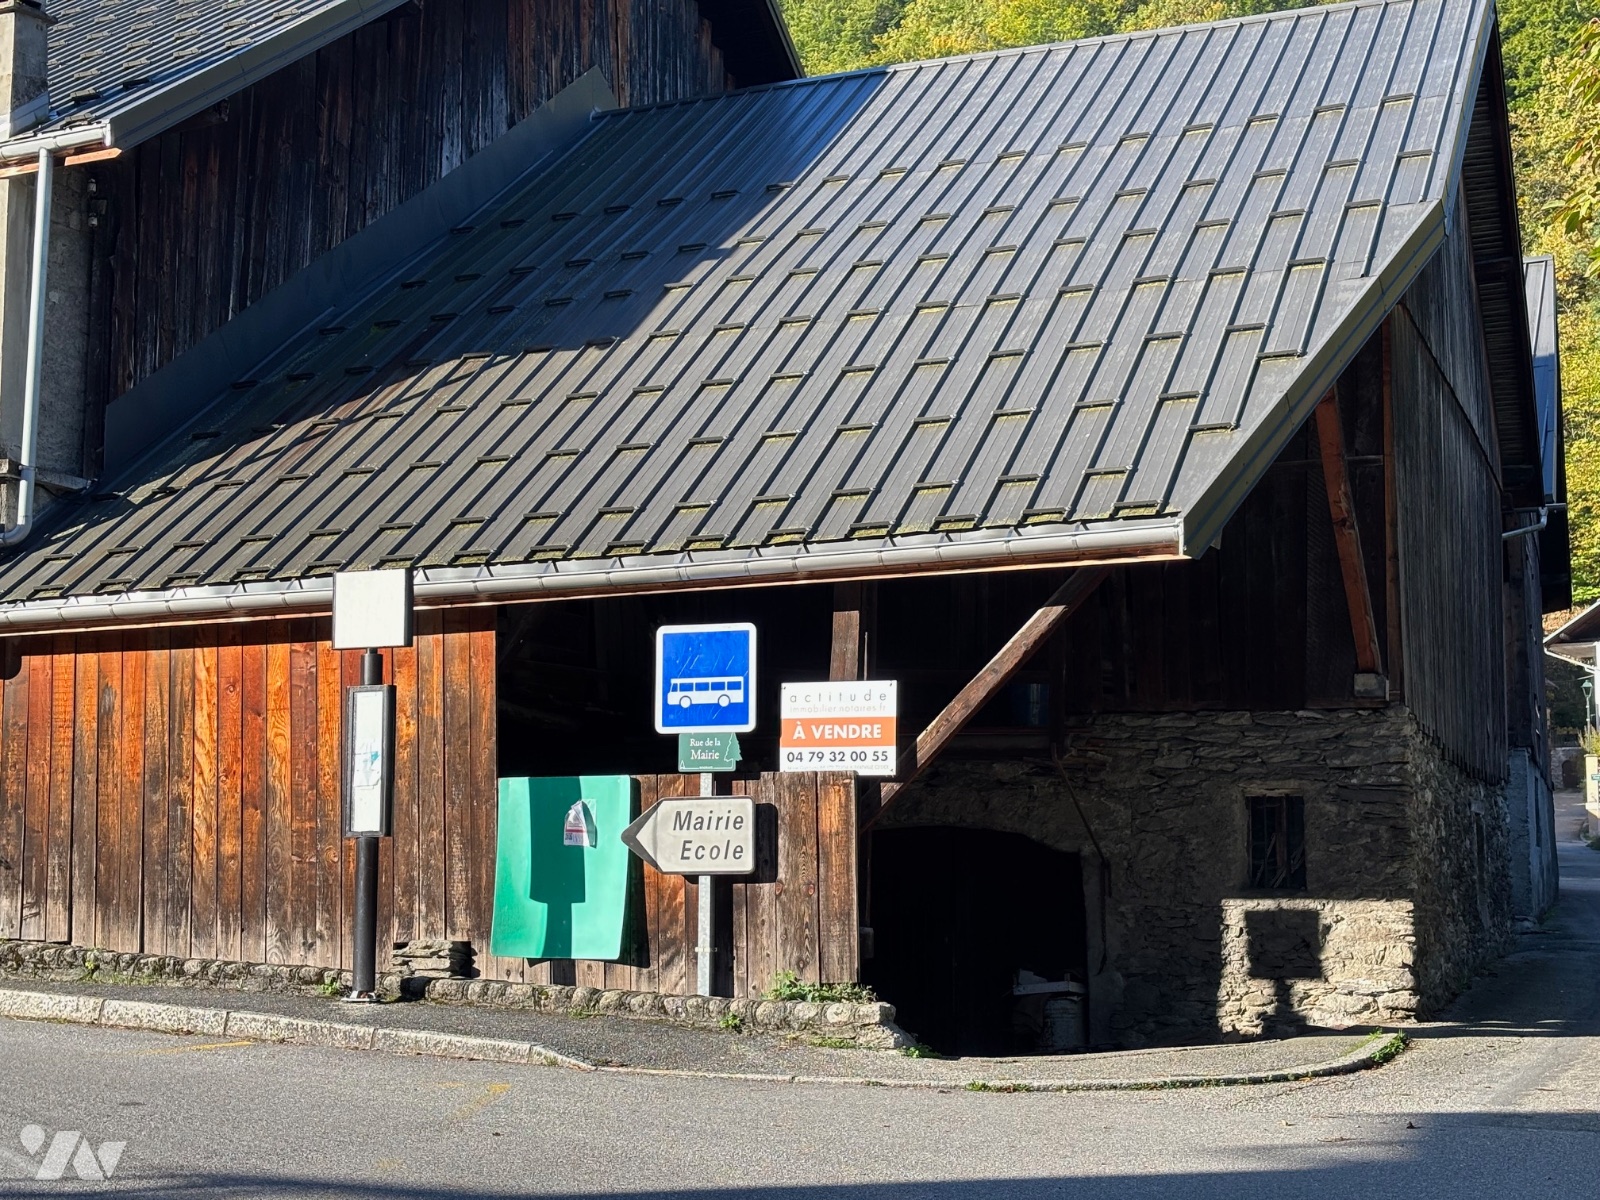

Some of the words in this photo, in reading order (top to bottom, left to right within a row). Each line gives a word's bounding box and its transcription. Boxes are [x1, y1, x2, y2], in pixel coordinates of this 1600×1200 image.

[789, 689, 887, 703] actitude
[792, 721, 806, 740] À
[811, 724, 882, 739] VENDRE
[690, 738, 704, 747] Rue
[704, 737, 714, 747] de
[714, 737, 721, 746] la
[690, 749, 720, 760] Mairie
[787, 752, 804, 762] 04
[808, 751, 825, 762] 79
[829, 751, 846, 762] 32
[850, 751, 867, 762] 00
[871, 750, 888, 762] 55
[673, 810, 744, 831] Mairie
[680, 839, 744, 860] Ecole
